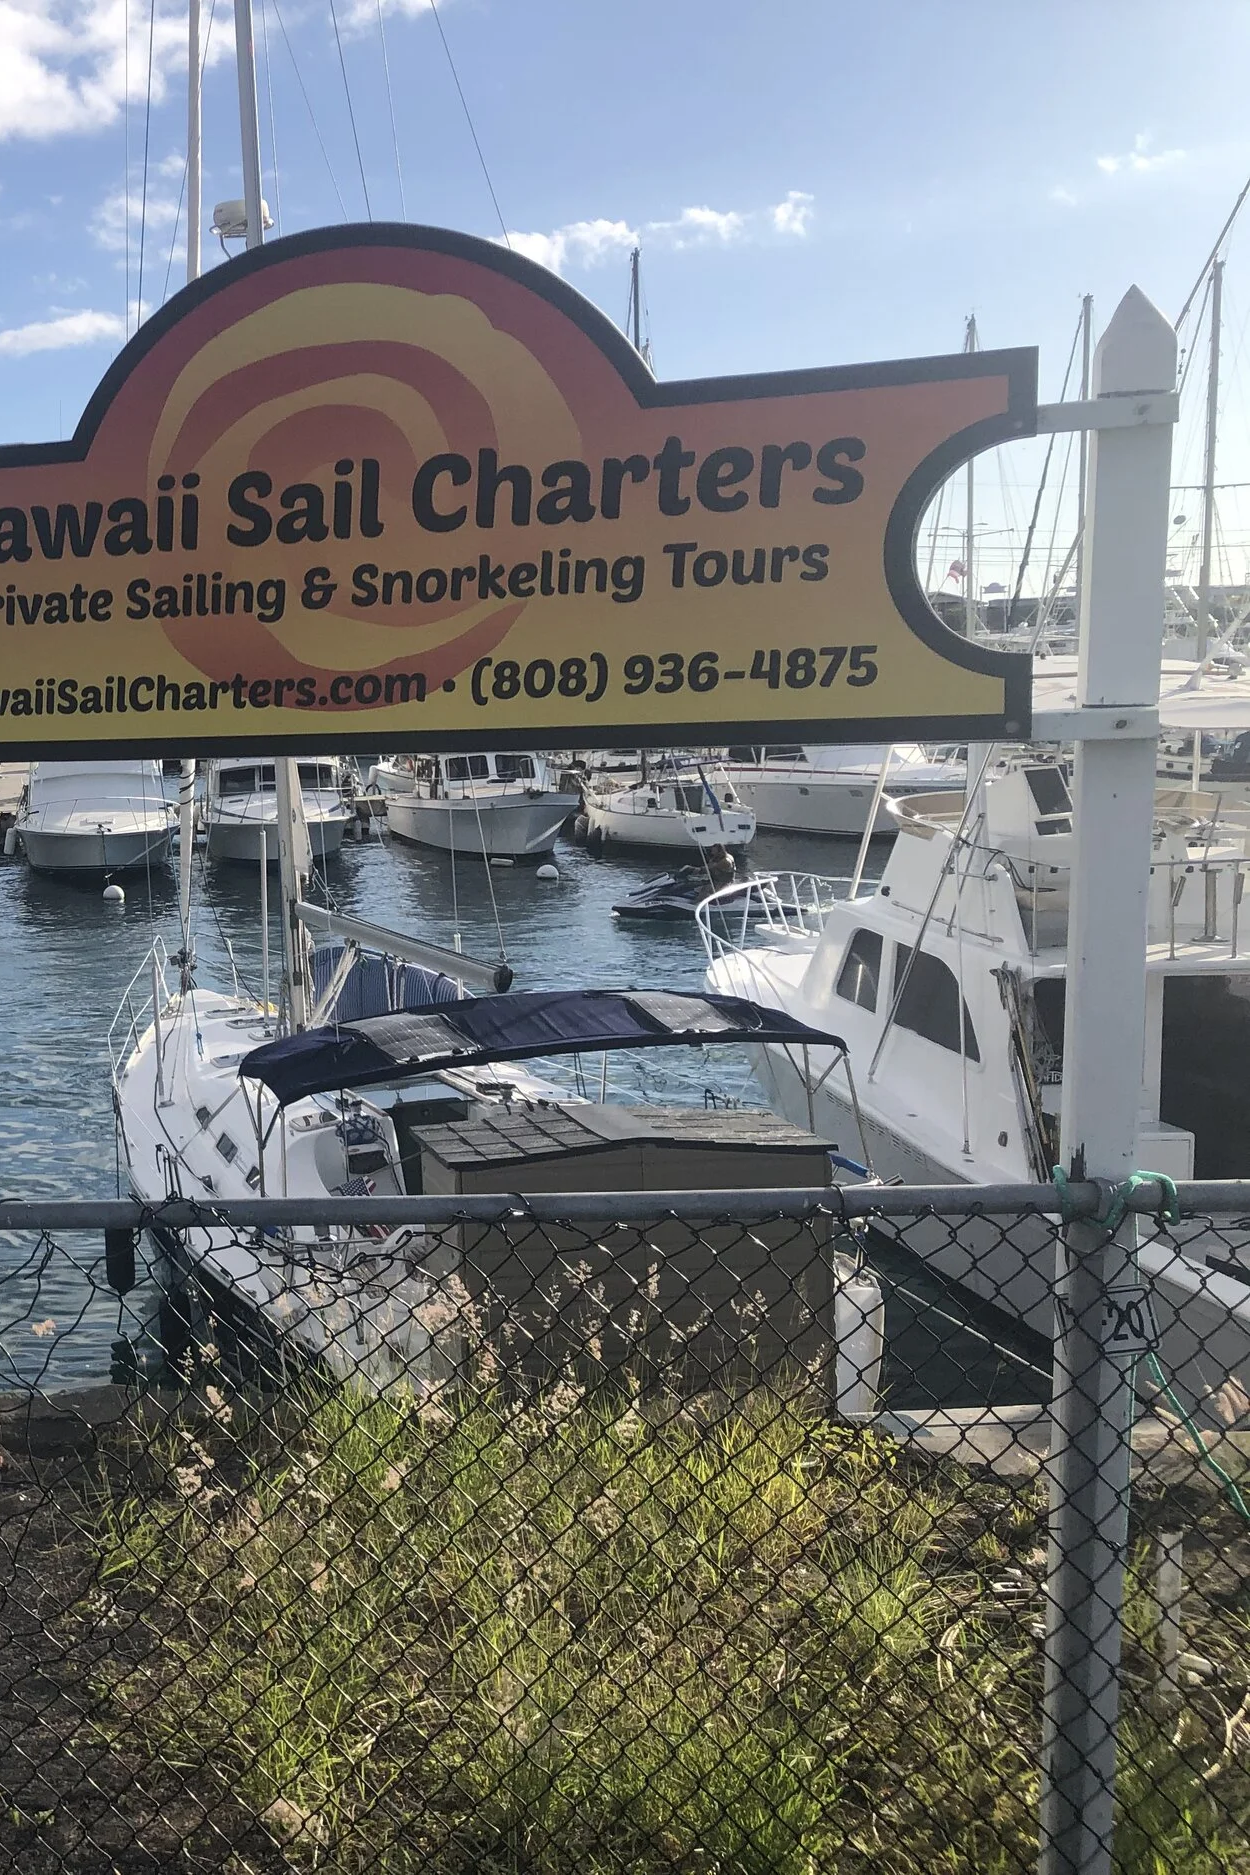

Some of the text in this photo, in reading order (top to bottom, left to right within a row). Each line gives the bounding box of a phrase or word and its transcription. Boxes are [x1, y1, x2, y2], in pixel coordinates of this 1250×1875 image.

[227, 458, 385, 548] Sail
[411, 436, 867, 533] Charters
[126, 570, 286, 623] Sailing
[301, 566, 339, 610] &
[351, 548, 646, 607] Snorkeling
[663, 542, 831, 590] Tours
[471, 652, 609, 708] (808)
[623, 645, 879, 696] 936-4875
